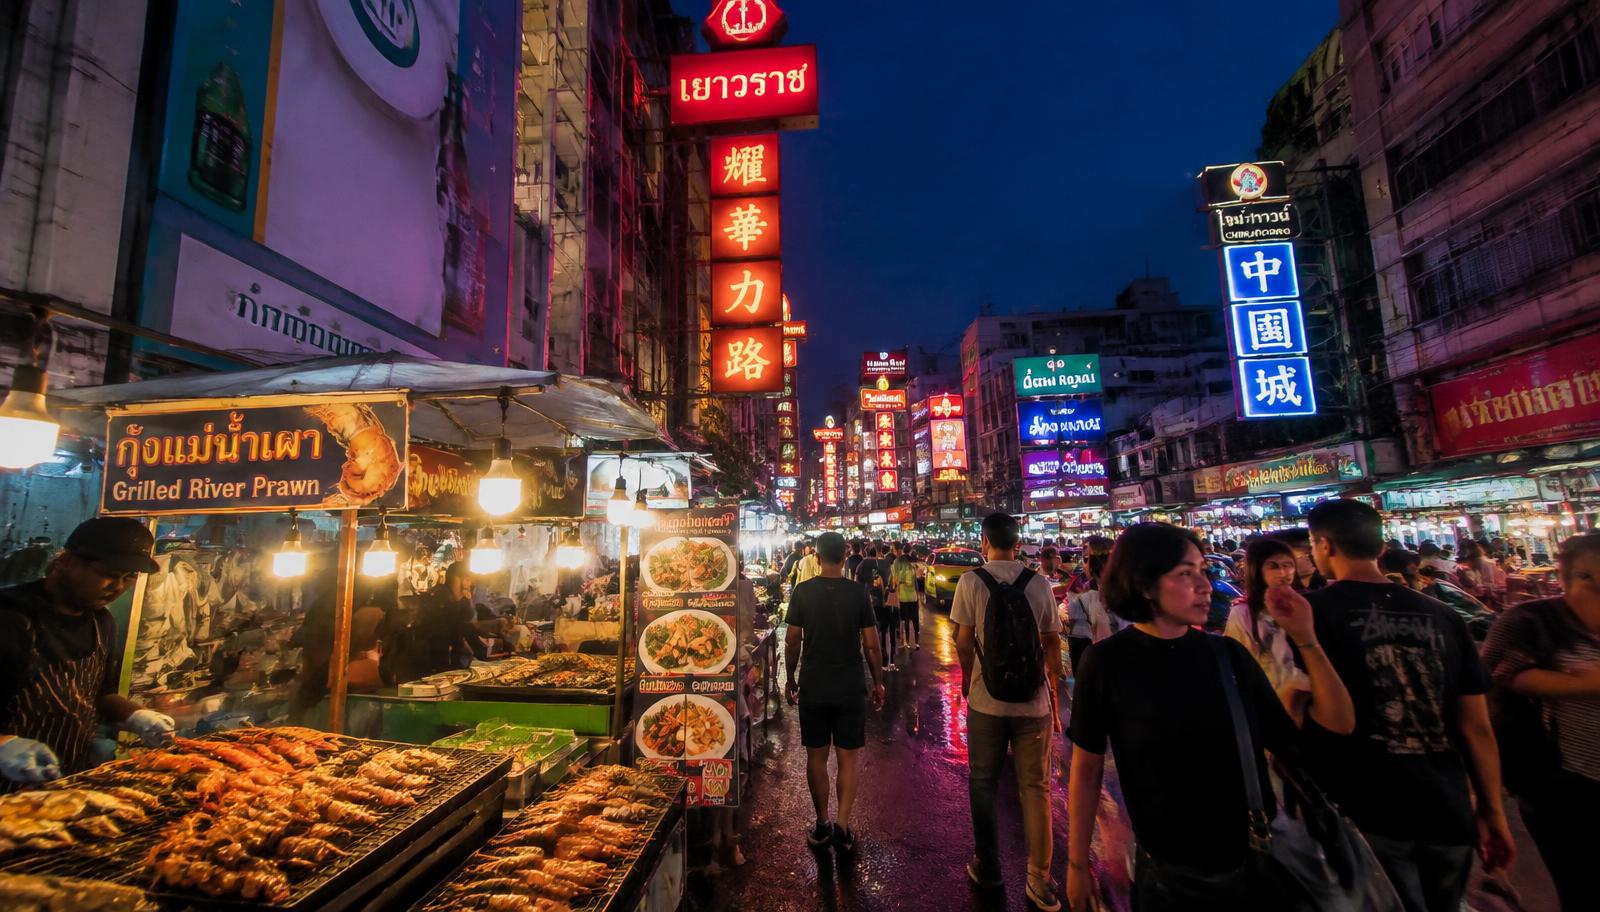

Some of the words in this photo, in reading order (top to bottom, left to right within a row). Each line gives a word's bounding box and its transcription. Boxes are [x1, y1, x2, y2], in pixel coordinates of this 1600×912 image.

[681, 63, 808, 102] เยาวราช
[723, 143, 772, 380] 耀華力路
[117, 412, 322, 478] กุ้งแม่น้ำเผา
[113, 479, 181, 501] Grilled
[189, 478, 246, 498] River
[252, 478, 320, 498] Prawn
